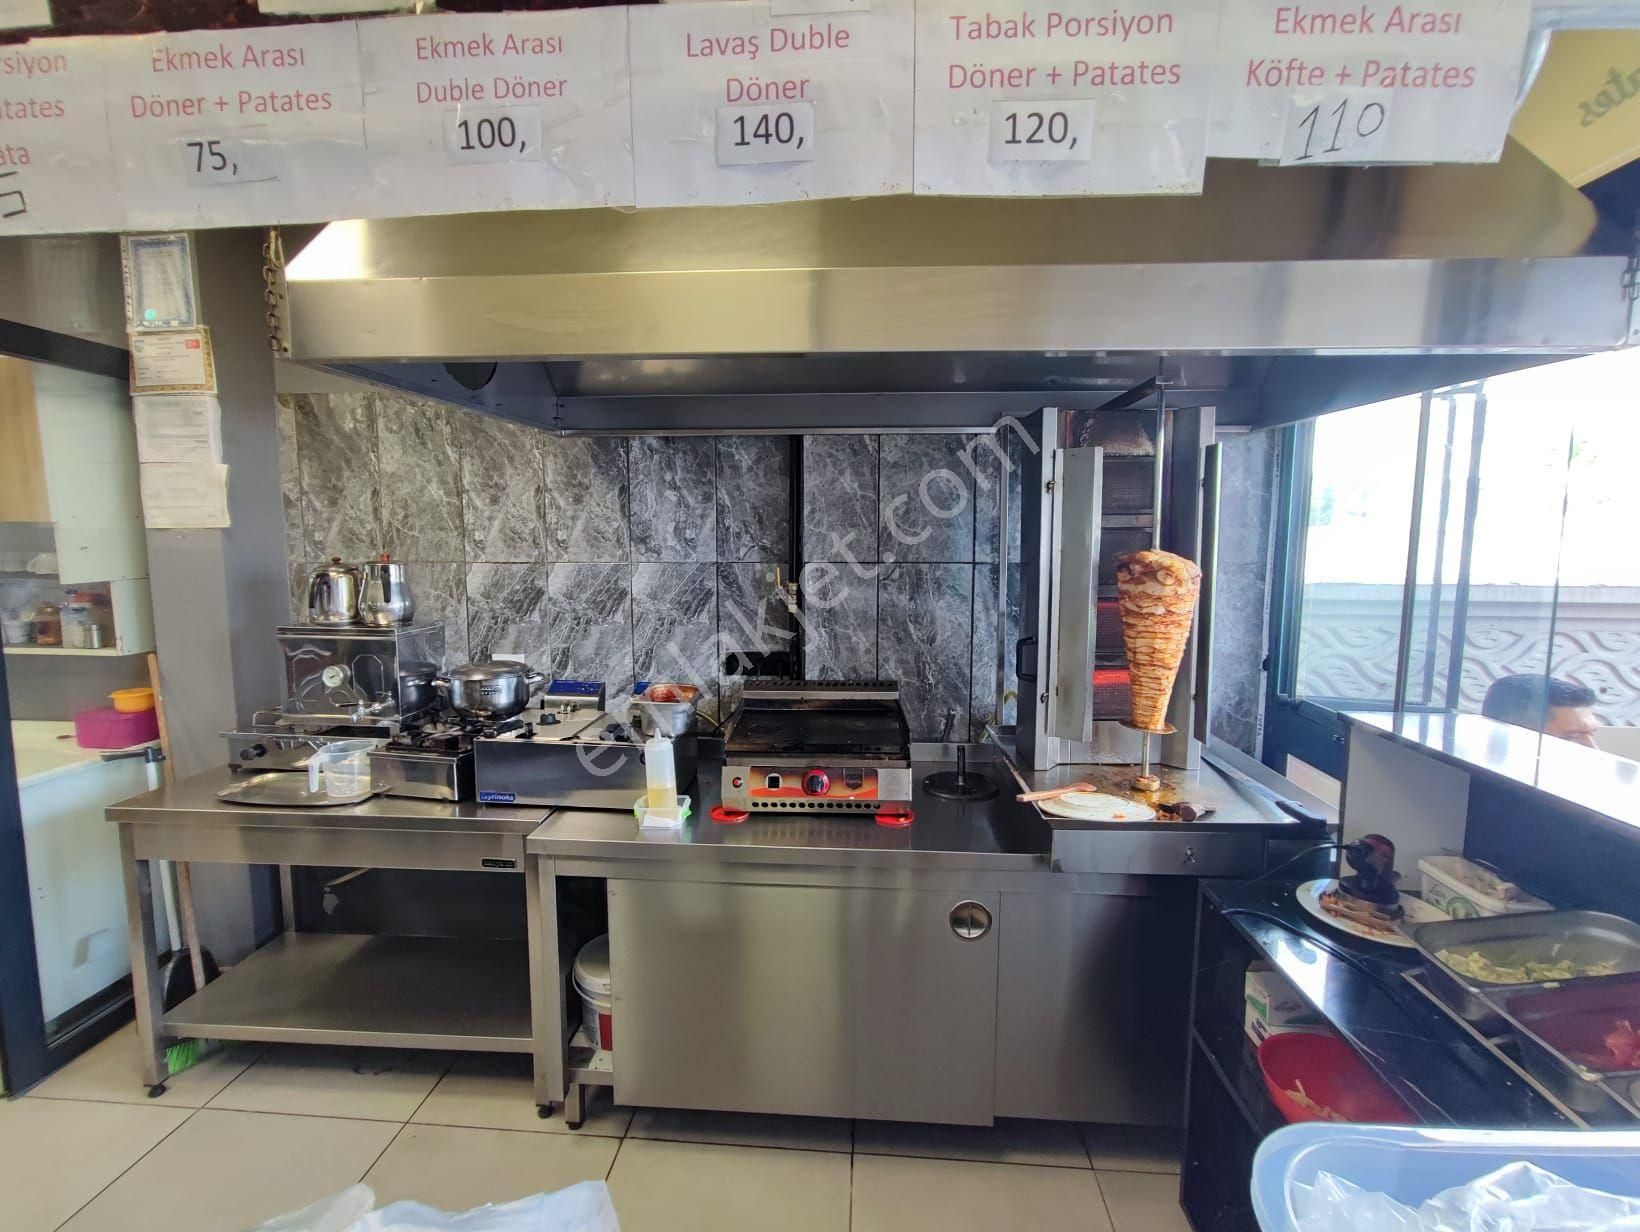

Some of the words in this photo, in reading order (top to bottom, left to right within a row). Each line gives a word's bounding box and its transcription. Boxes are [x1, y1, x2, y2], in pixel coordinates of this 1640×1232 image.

[949, 12, 1036, 41] Tabak
[1046, 10, 1175, 42] Porsiyon
[1275, 6, 1373, 35] Ekmek
[1384, 6, 1463, 34] Arası
[416, 34, 496, 61] Ekmek
[502, 33, 564, 56] Arası
[686, 33, 760, 60] Lavaş
[771, 24, 851, 53] Duble
[0, 51, 68, 79] siyon
[152, 45, 233, 73] Ekmek
[242, 45, 306, 70] Arası
[1245, 58, 1325, 88] Köfte
[1335, 67, 1352, 86] +
[1361, 60, 1476, 89] Patates
[726, 77, 810, 103] Döner
[949, 62, 1036, 90] Döner
[1046, 67, 1063, 84] +
[1073, 60, 1182, 88] Patates
[130, 94, 206, 119] Döner
[214, 96, 230, 112] +
[238, 91, 333, 114] Patates
[416, 79, 486, 104] Duble
[493, 77, 568, 101] Döner
[0, 97, 65, 120] tates
[458, 117, 526, 153] 100,
[733, 113, 804, 150] 140,
[1004, 112, 1078, 150] 120,
[1295, 98, 1386, 161] 110
[186, 140, 238, 176] 75,
